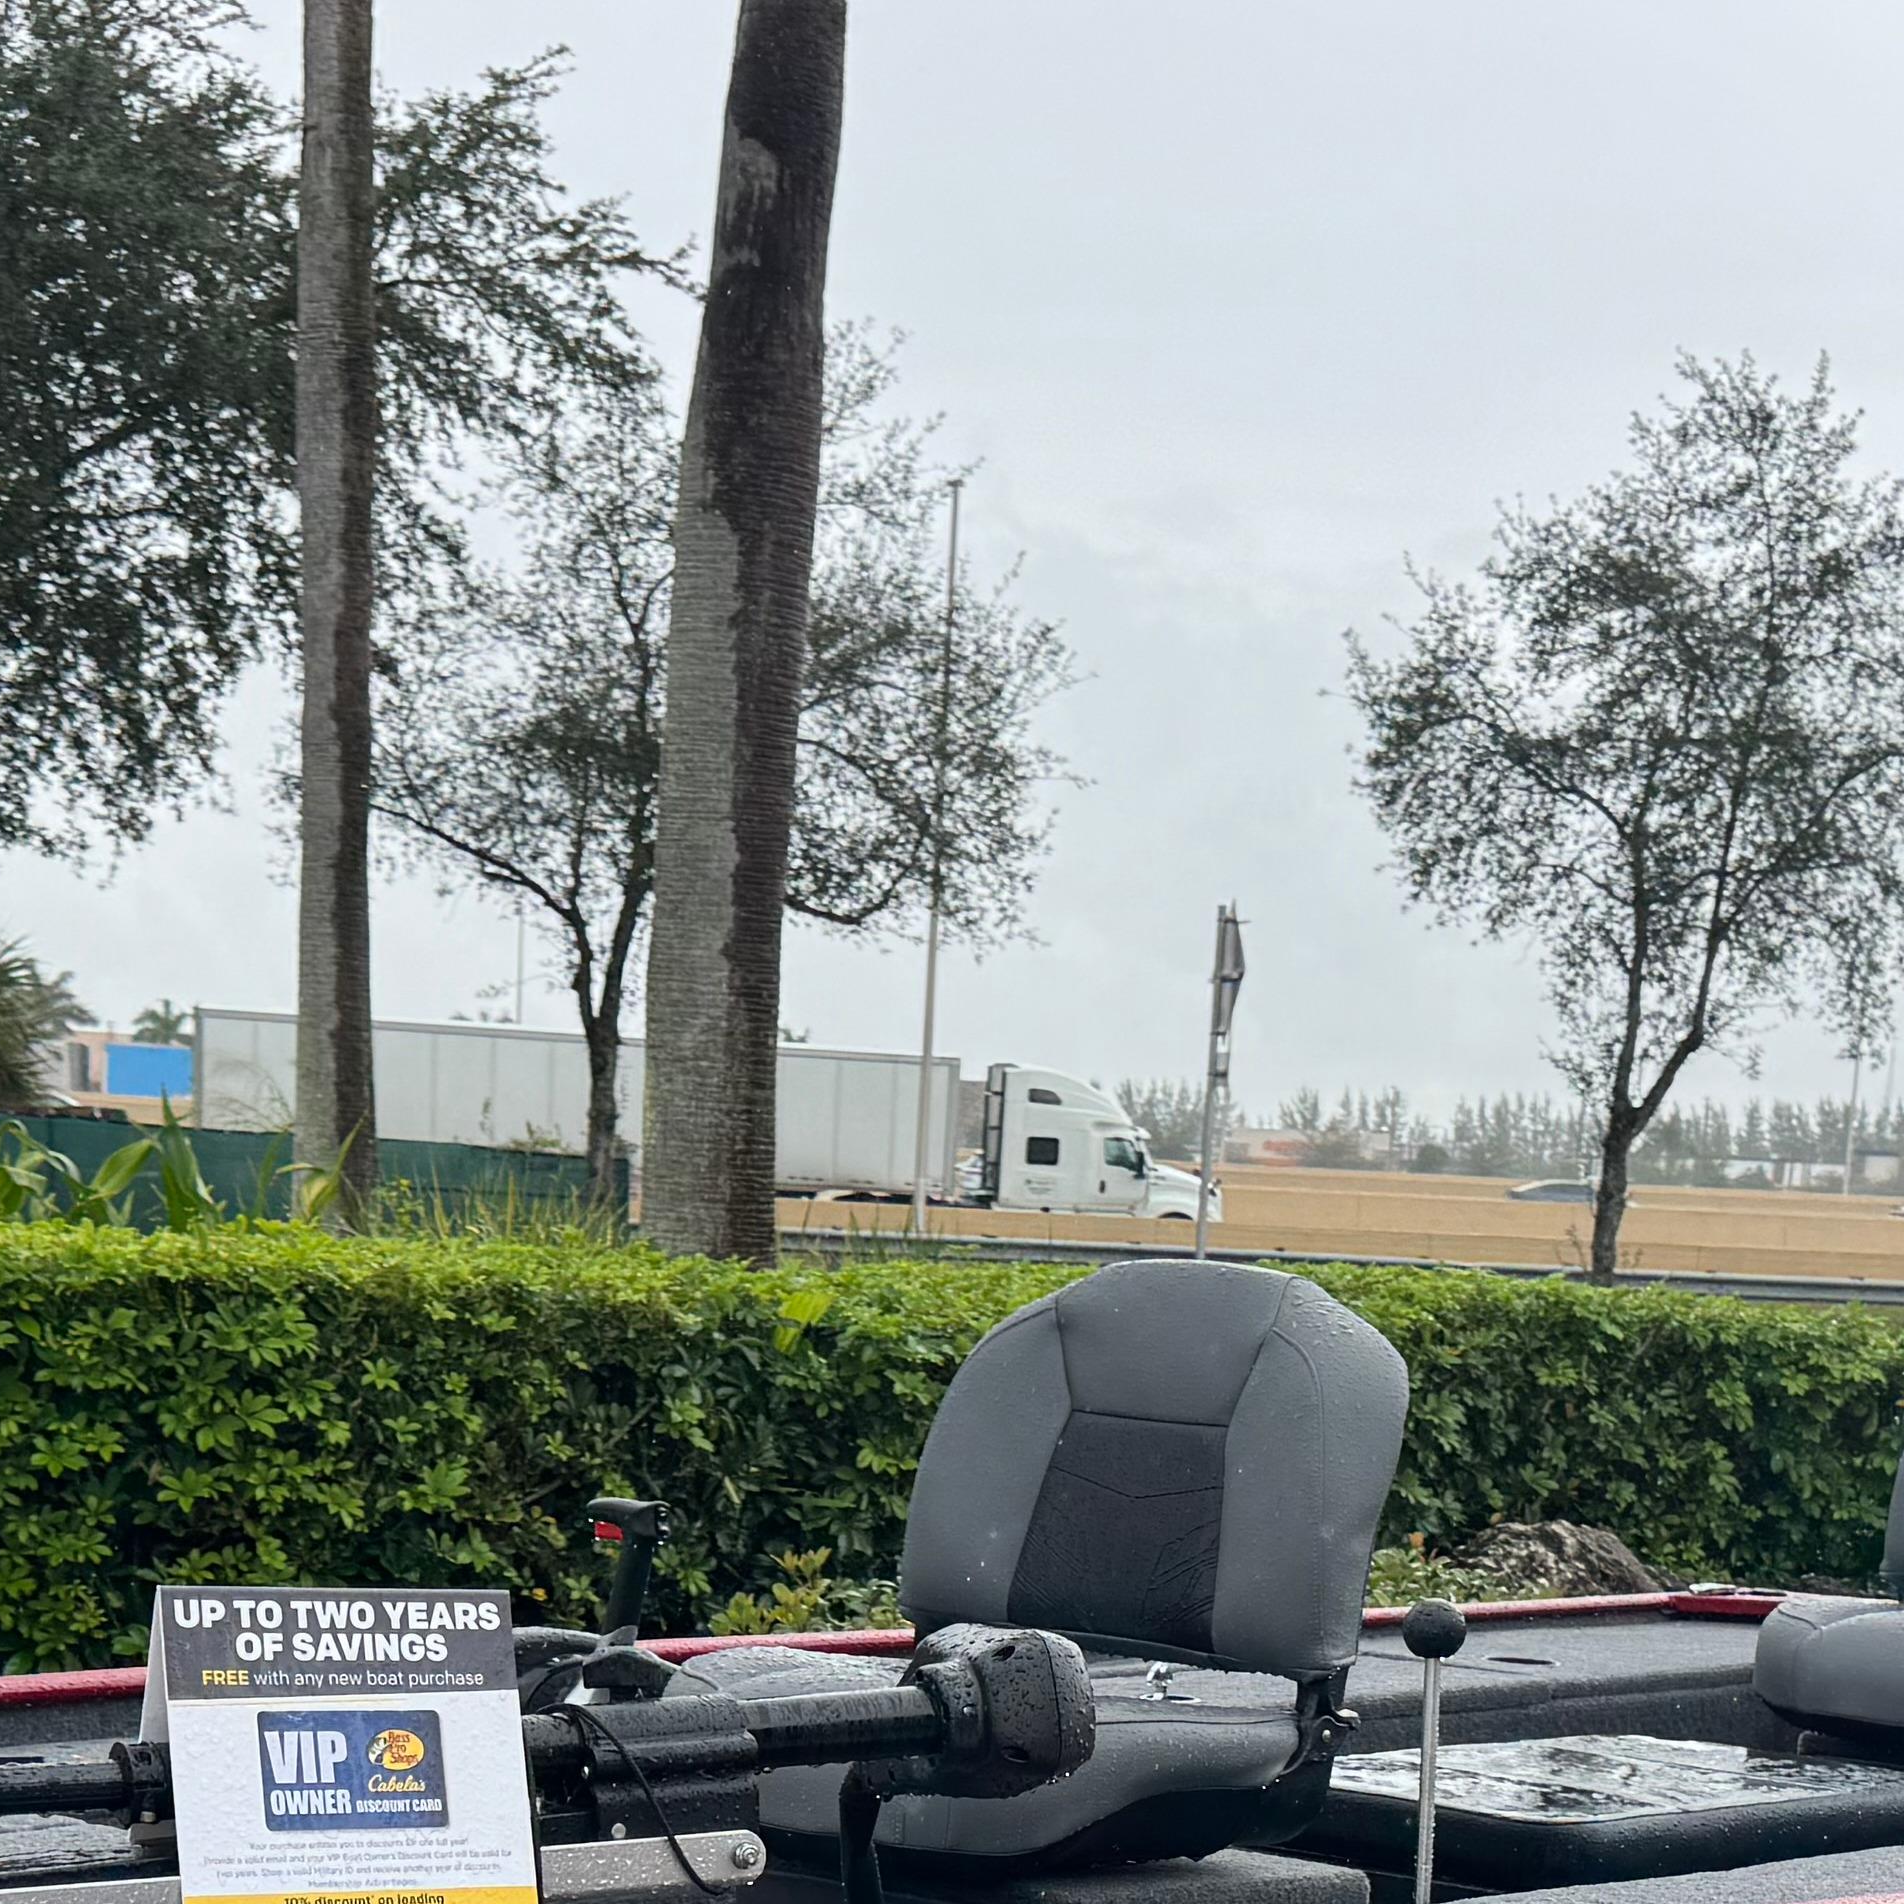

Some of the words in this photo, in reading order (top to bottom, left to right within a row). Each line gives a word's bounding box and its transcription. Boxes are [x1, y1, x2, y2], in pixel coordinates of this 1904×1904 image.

[173, 1599, 226, 1629] UP
[233, 1600, 283, 1629] TO
[290, 1600, 376, 1630] TWO
[382, 1602, 501, 1631] YEARS
[235, 1632, 283, 1662] OF
[292, 1632, 448, 1662] SAVINGS
[201, 1669, 250, 1686] FREE
[253, 1670, 290, 1686] with
[294, 1673, 325, 1689] any
[328, 1673, 362, 1686] new
[366, 1670, 404, 1685] boat
[409, 1670, 484, 1688] purchase
[388, 1732, 410, 1742] Bass
[264, 1730, 348, 1784] VIP
[390, 1743, 406, 1753] Pro
[390, 1752, 418, 1765] Shops
[368, 1774, 425, 1792] Cabela's
[270, 1789, 352, 1815] OWNER
[356, 1800, 410, 1814] DISCOUNT
[412, 1799, 443, 1812] CARD
